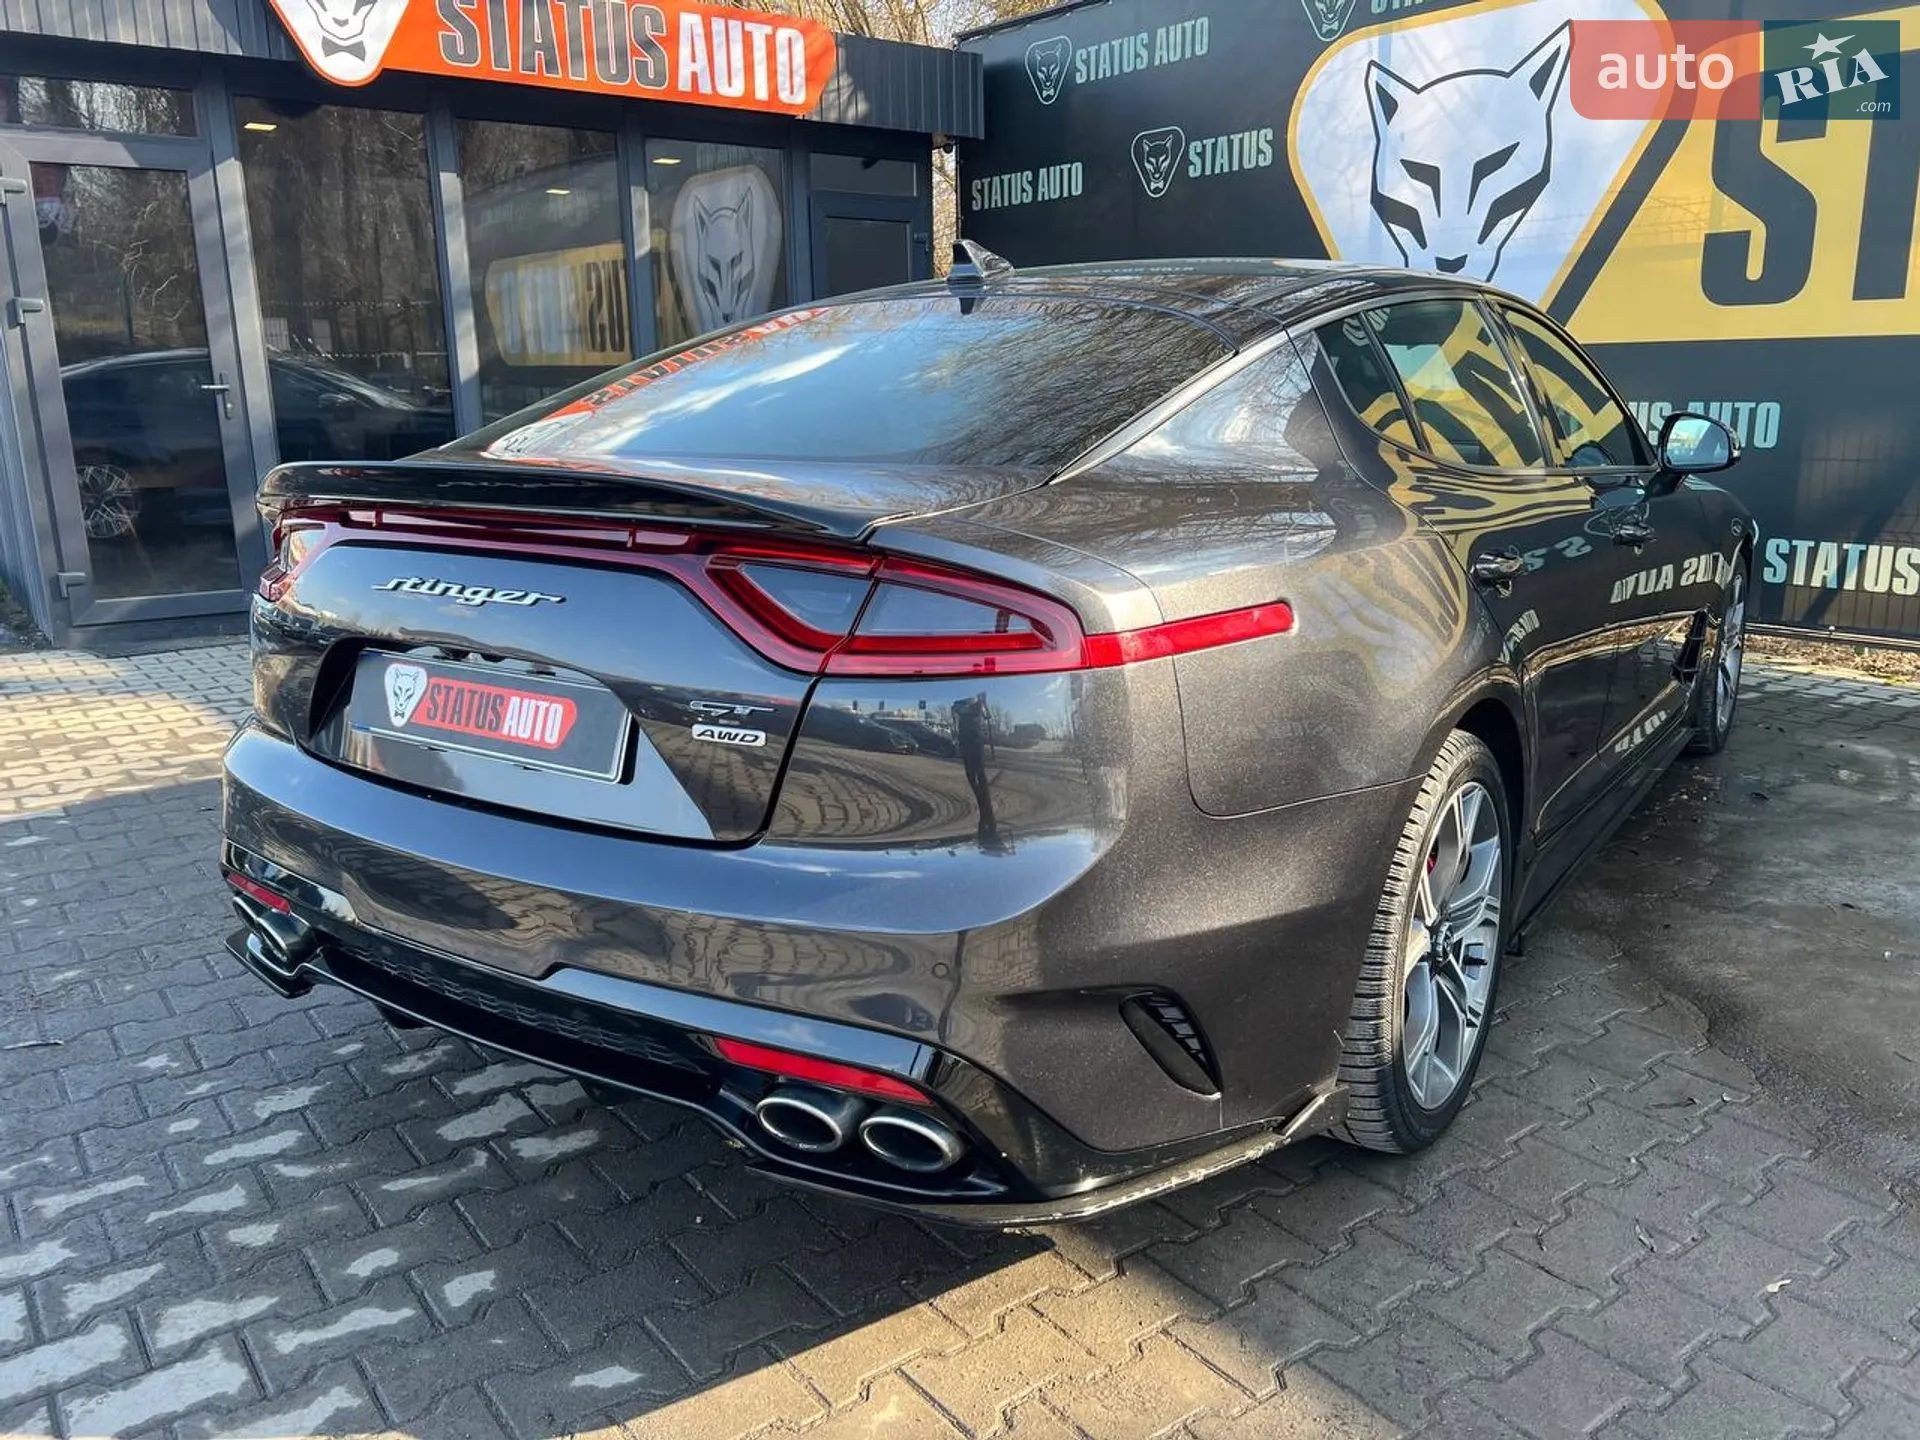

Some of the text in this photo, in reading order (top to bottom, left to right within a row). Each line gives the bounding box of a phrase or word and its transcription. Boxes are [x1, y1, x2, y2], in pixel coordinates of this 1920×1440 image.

[436, 0, 806, 105] STATUS AUTO
[1075, 16, 1210, 84] STATUS AUTO
[1188, 127, 1275, 179] STATUS
[971, 162, 1083, 212] STATUS AUTO
[1687, 401, 1781, 448] TO
[1762, 537, 1920, 596] STATUS
[427, 684, 564, 745] STATUS AUTO
[697, 728, 760, 743] AWD
